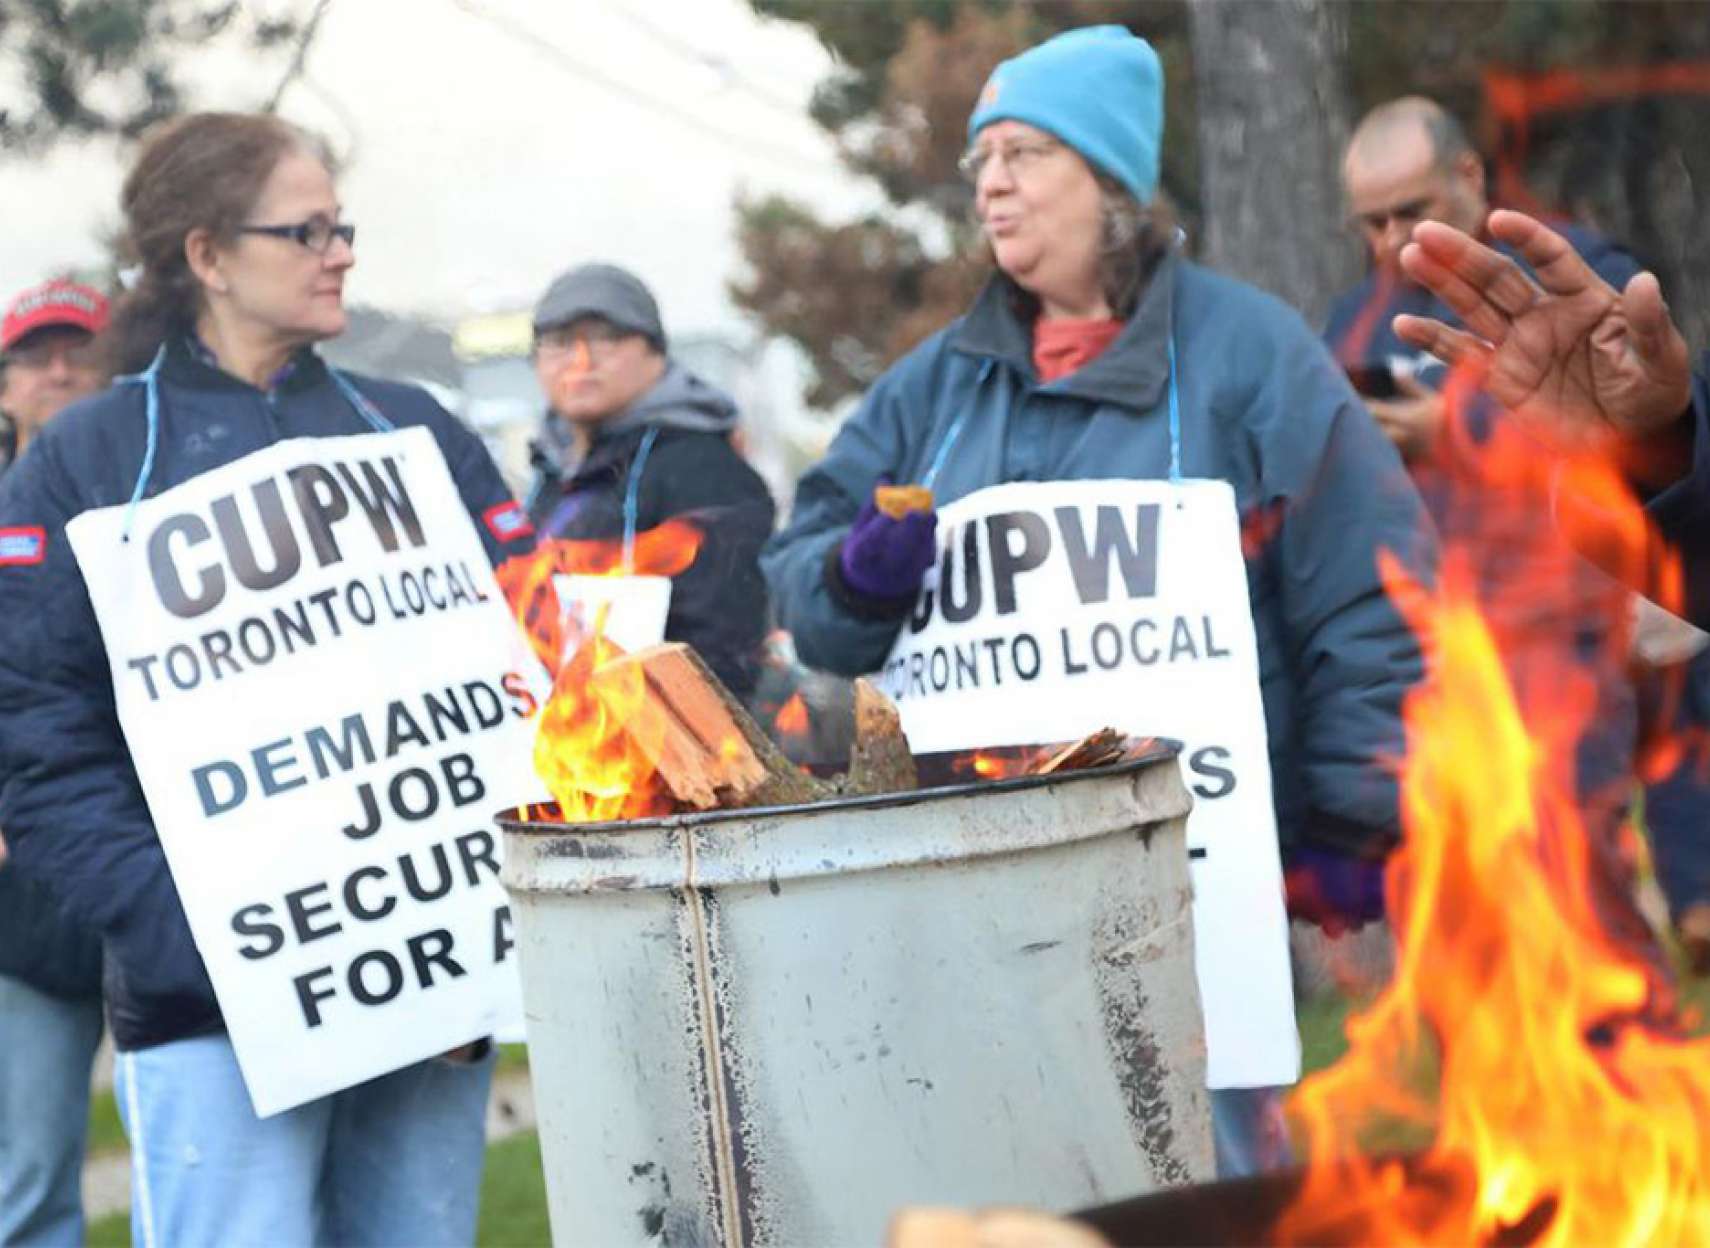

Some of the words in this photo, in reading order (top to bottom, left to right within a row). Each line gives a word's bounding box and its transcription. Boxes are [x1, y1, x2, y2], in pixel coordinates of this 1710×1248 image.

[146, 456, 427, 619] CUPW
[128, 579, 377, 701] TORONTO
[379, 560, 489, 621] LOCAL
[886, 633, 1042, 701] RONTO
[1060, 615, 1231, 675] LOCAL
[190, 671, 540, 818] DEMANDS
[341, 752, 486, 840] JOB
[230, 829, 501, 961] SECUR
[292, 928, 468, 1028] FOR
